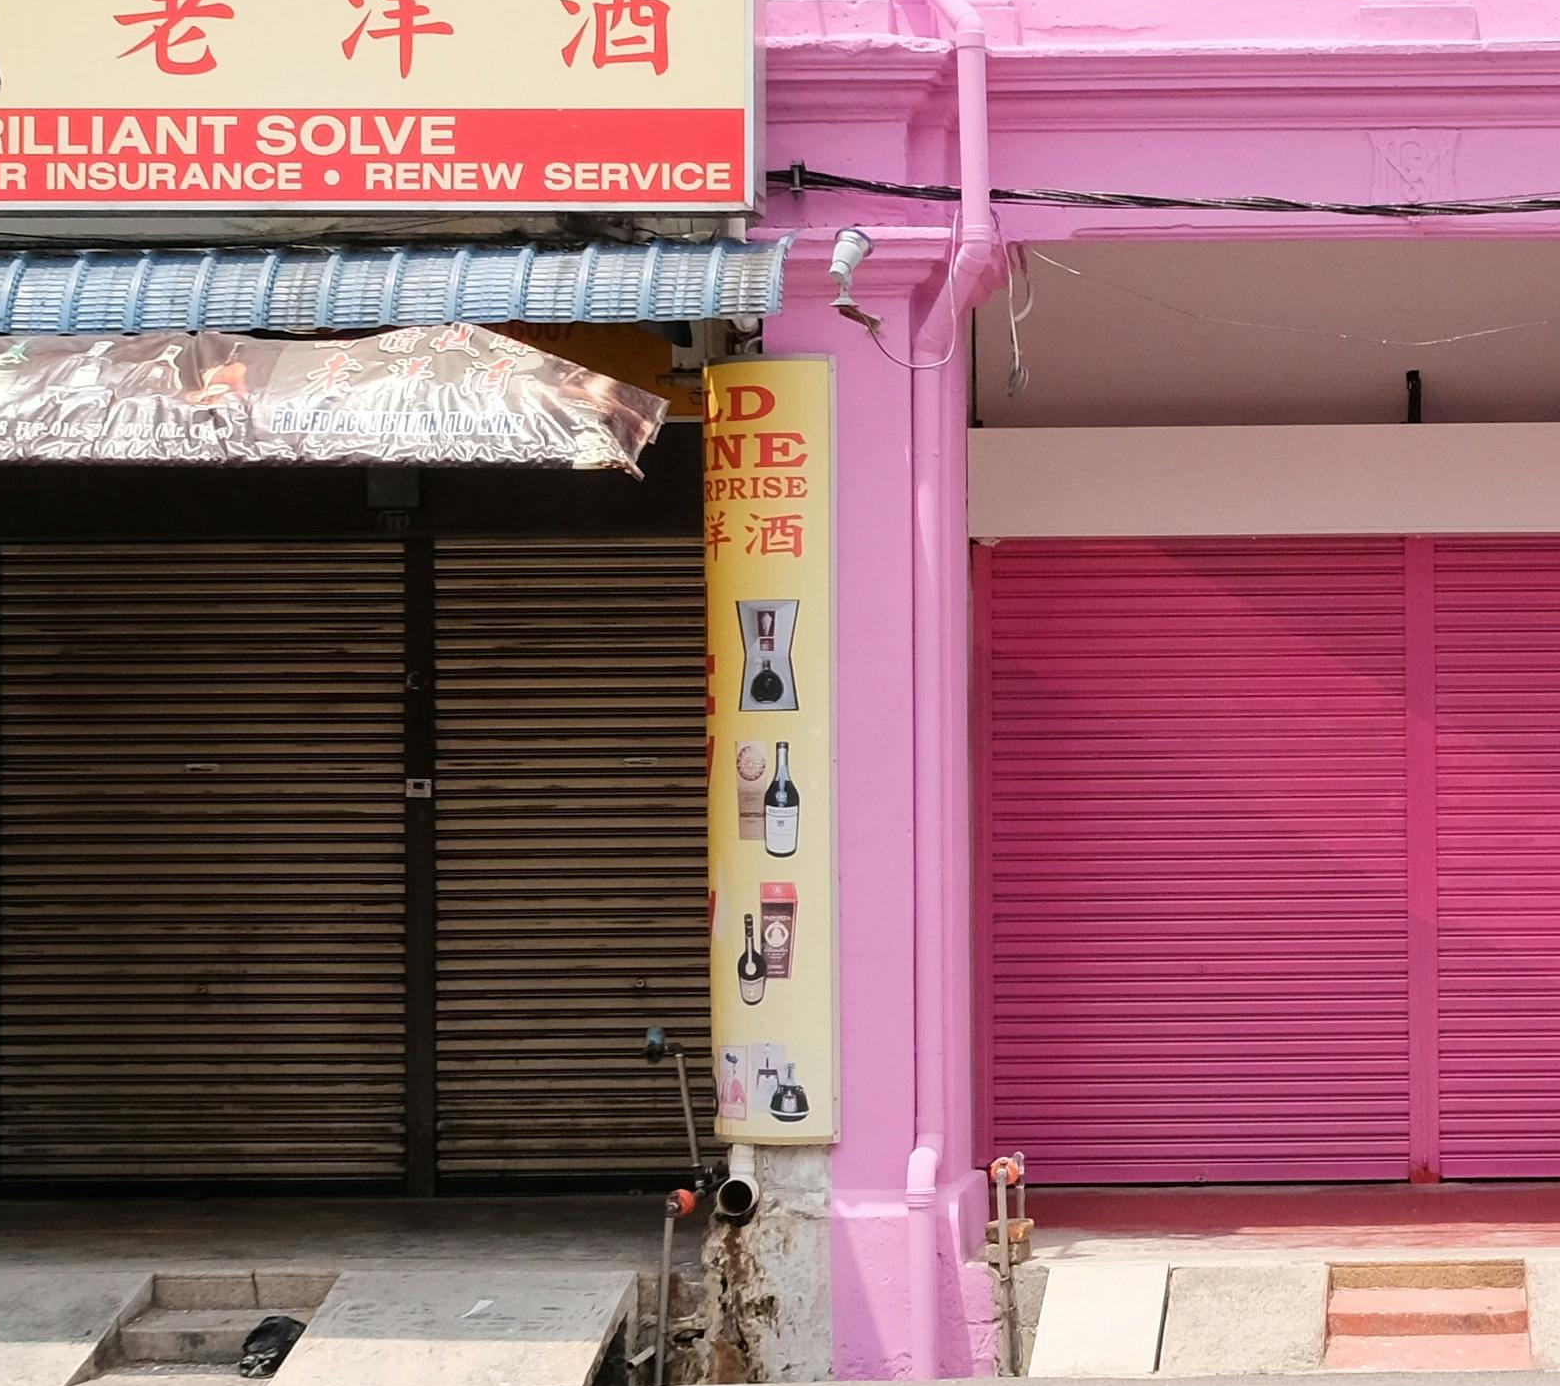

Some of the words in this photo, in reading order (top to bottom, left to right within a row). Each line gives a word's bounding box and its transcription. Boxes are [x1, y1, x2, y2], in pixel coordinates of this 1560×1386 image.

[257, 116, 455, 155] SOLVE
[47, 162, 302, 190] INSURANCE
[366, 163, 523, 189] RENEW
[544, 163, 730, 190] SERVICE
[704, 433, 808, 472] NE
